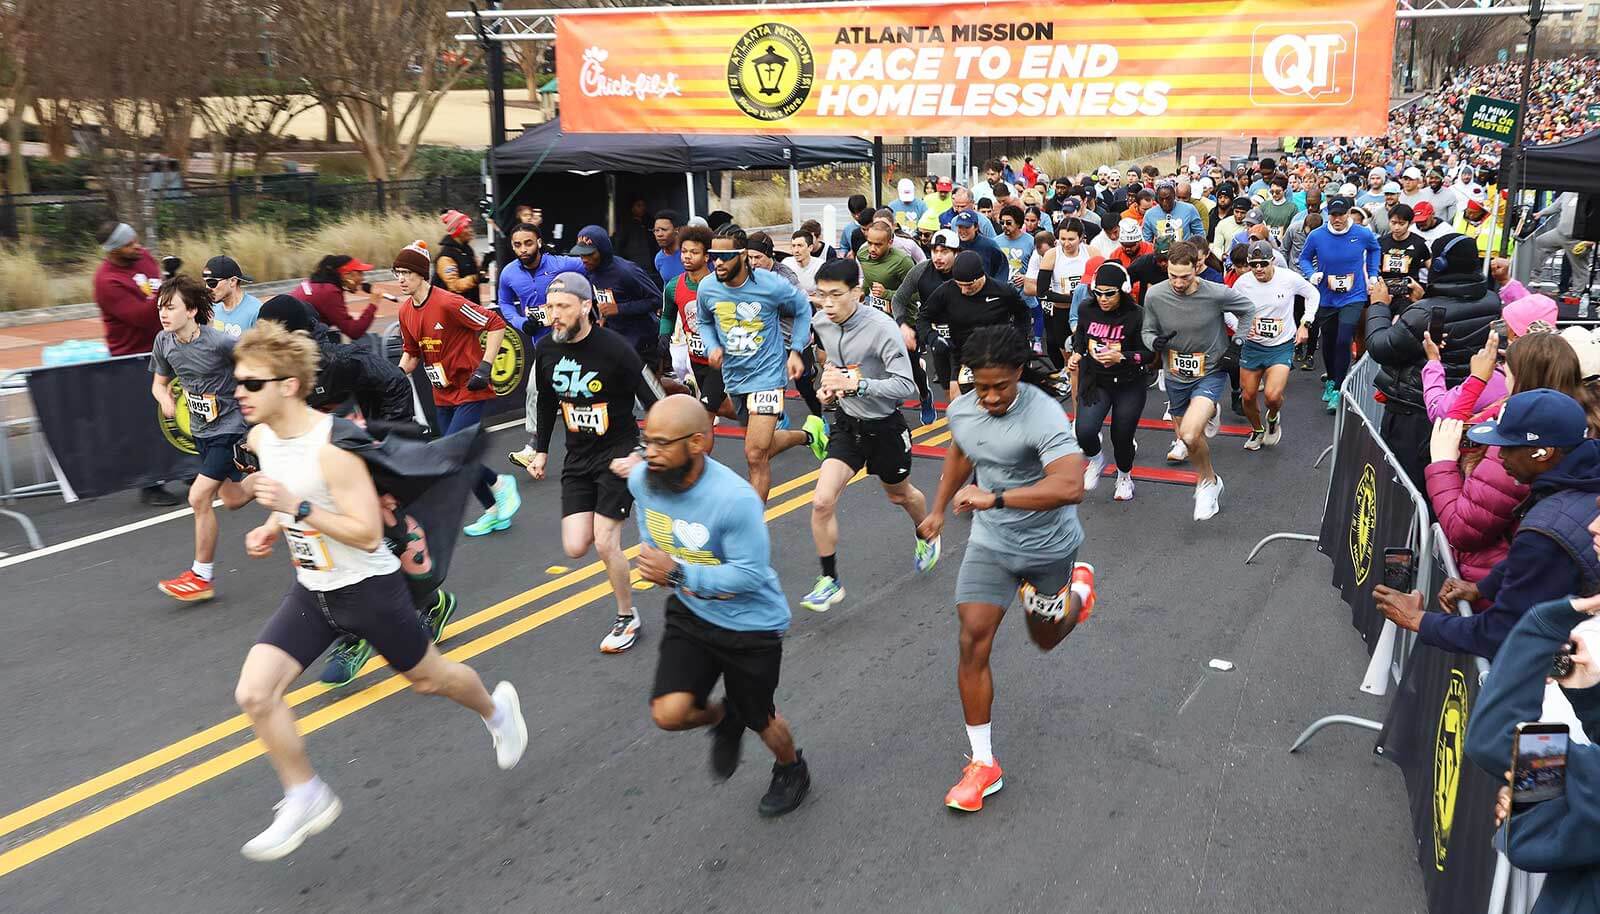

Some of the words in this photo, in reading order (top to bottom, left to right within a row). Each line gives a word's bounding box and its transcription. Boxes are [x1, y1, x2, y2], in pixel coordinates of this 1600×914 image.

[835, 25, 945, 44] ATLANTA
[951, 22, 1054, 42] MISSION
[731, 24, 772, 66] ATLANTA
[774, 25, 811, 64] MISSION
[825, 47, 945, 81] RACE
[953, 45, 1011, 80] TO
[1018, 43, 1119, 79] END
[1262, 33, 1346, 99] QT
[816, 80, 1172, 117] HOMELESSNESS
[1471, 119, 1511, 134] FASTER
[1472, 111, 1498, 123] MILE
[1498, 117, 1514, 127] OR
[1087, 321, 1110, 338] RUN
[1257, 322, 1278, 332] 1314
[1174, 358, 1199, 369] 1890
[552, 355, 600, 398] 5K
[753, 393, 779, 404] 1204
[570, 412, 600, 425] 1471
